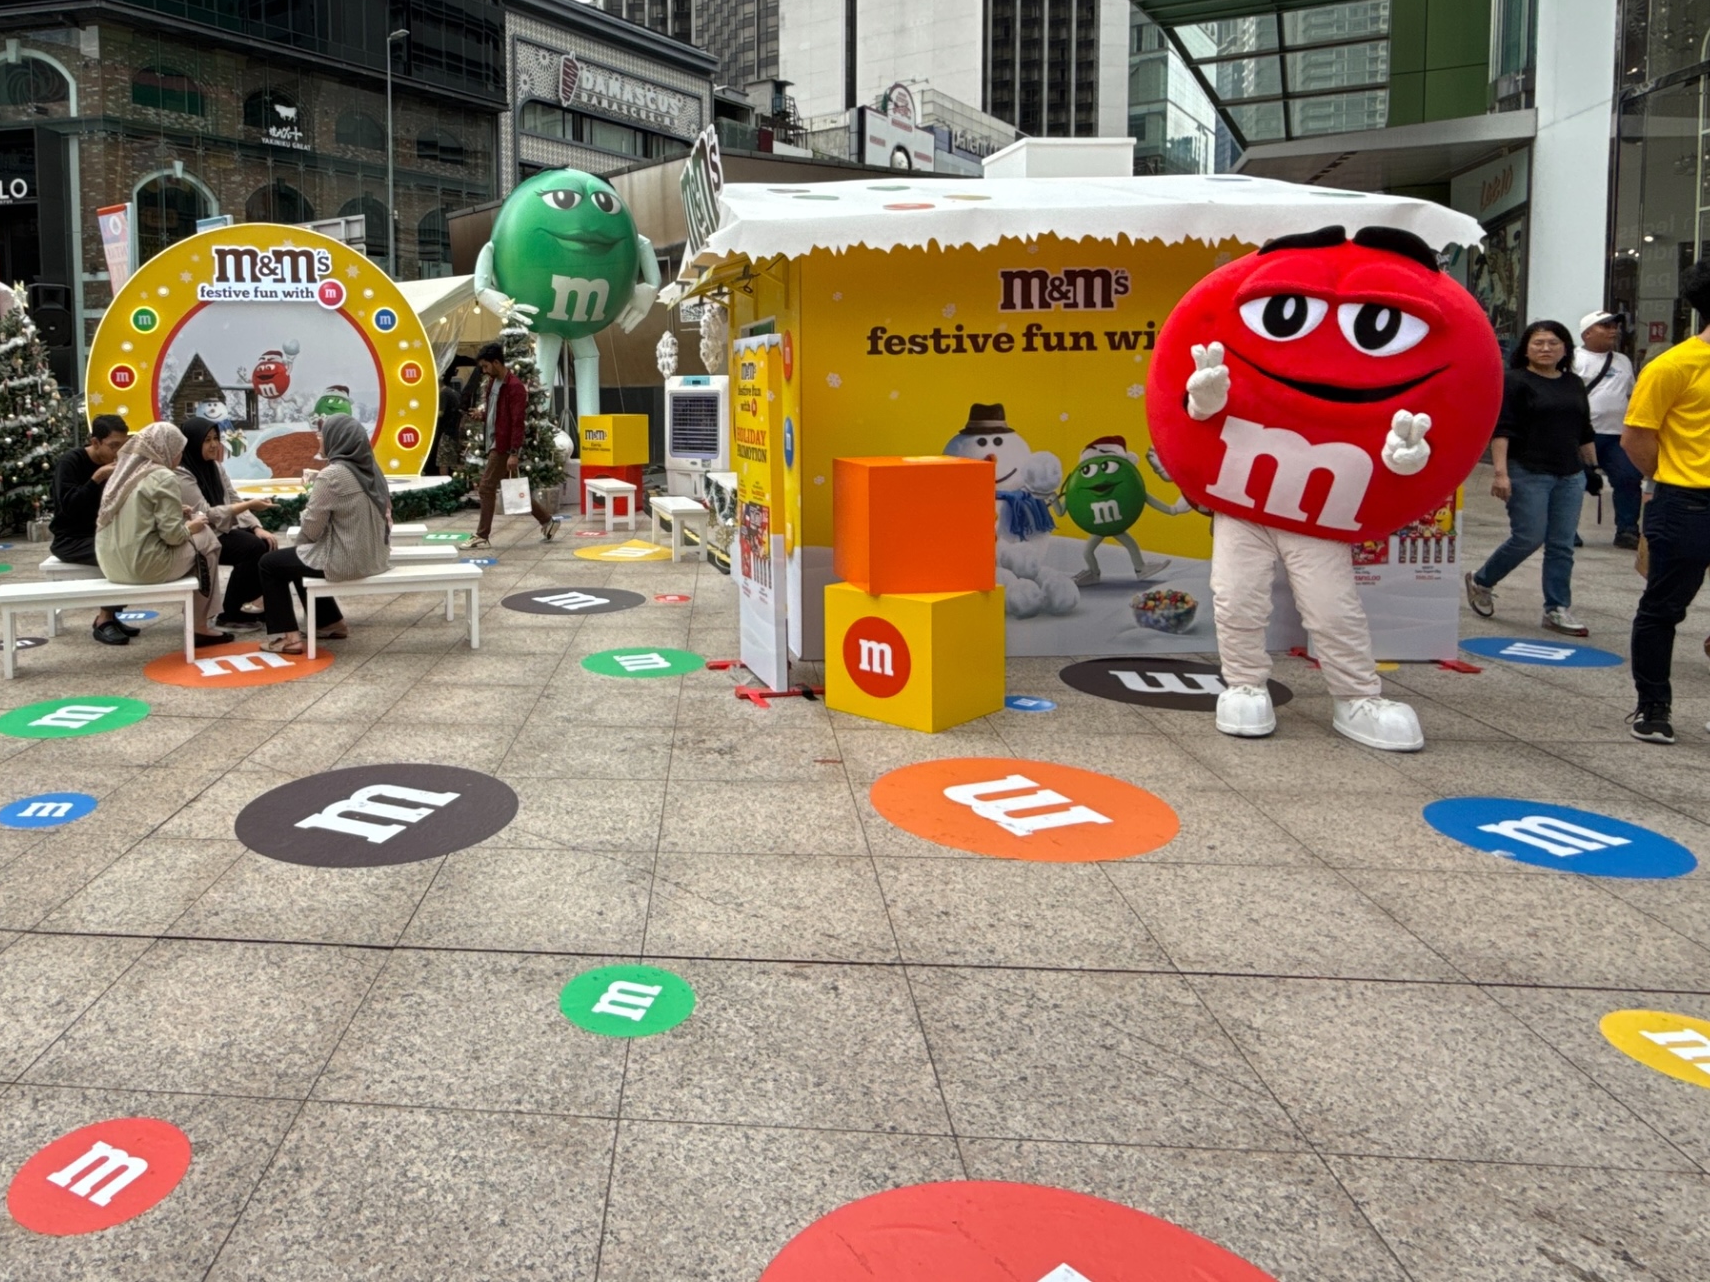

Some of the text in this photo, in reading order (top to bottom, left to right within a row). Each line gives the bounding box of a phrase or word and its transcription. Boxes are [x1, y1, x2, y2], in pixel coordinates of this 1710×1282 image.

[200, 285, 251, 301] festive
[253, 285, 279, 299] fun
[281, 284, 314, 298] with
[547, 274, 609, 321] m
[866, 323, 1015, 357] festive
[1021, 323, 1102, 352] fun
[1207, 416, 1371, 530] m
[860, 640, 893, 675] m
[29, 706, 117, 728] m
[295, 785, 460, 843] m
[592, 981, 662, 1021] m
[47, 1141, 148, 1206] m
